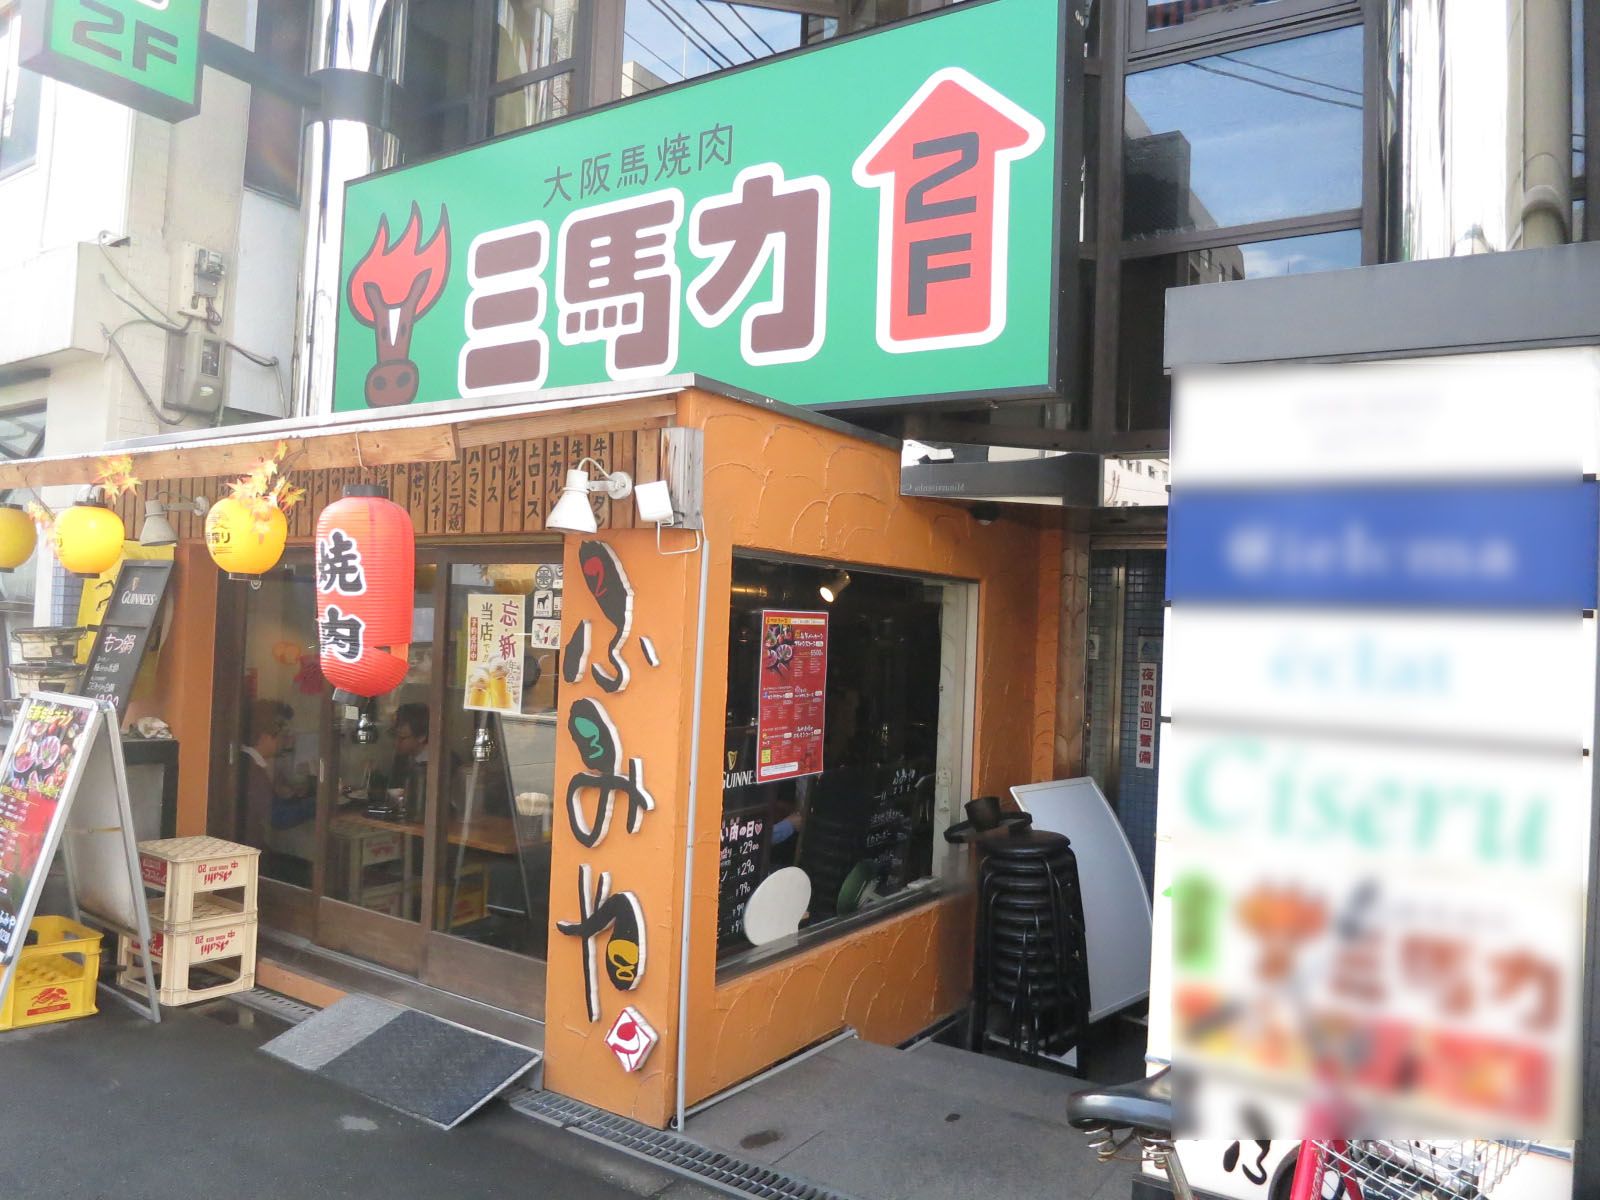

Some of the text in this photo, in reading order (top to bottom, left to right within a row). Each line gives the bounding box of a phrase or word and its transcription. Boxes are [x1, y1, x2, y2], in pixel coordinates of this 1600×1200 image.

[72, 0, 179, 72] 2F
[543, 122, 734, 209] 大阪馬焼肉
[904, 131, 980, 318] 2F
[464, 172, 822, 392] 三馬力
[468, 450, 480, 508] ハラミ
[487, 446, 501, 502] ロース
[508, 445, 521, 501] カルビ
[526, 442, 541, 520] 上ロース
[549, 440, 562, 514] 上カル
[121, 590, 156, 607] GUINNESS
[318, 528, 367, 664] 焼肉
[1138, 667, 1156, 765] 夜間巡回警備
[197, 863, 207, 874] 20
[204, 870, 233, 885] Asahi
[194, 934, 204, 945] 20
[201, 940, 229, 955] Asahi
